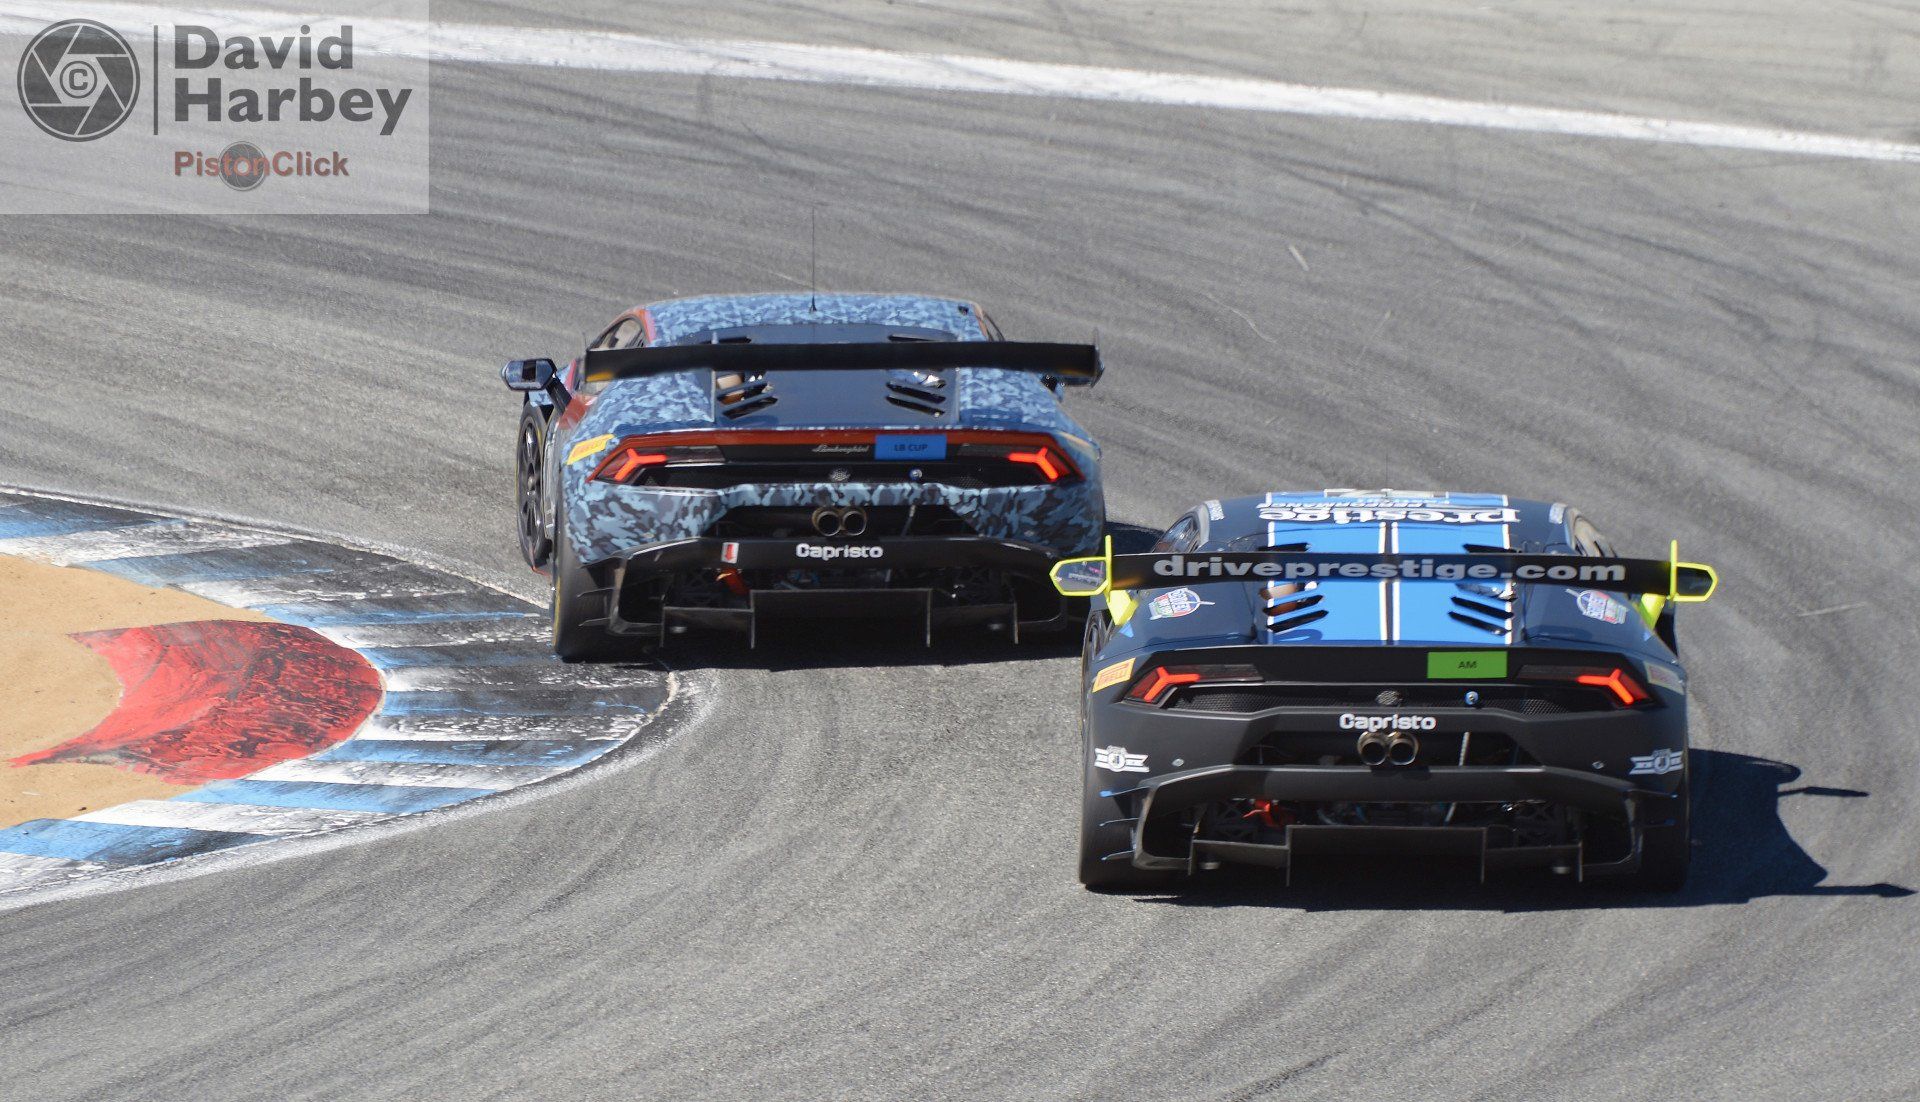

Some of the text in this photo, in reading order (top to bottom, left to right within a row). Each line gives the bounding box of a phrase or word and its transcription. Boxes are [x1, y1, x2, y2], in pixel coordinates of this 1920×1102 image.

[1258, 506, 1521, 525] prestige
[795, 542, 884, 561] Capristo
[1153, 555, 1626, 581] driveprestige.com
[1458, 660, 1477, 669] AM
[1339, 713, 1437, 732] Capristo
